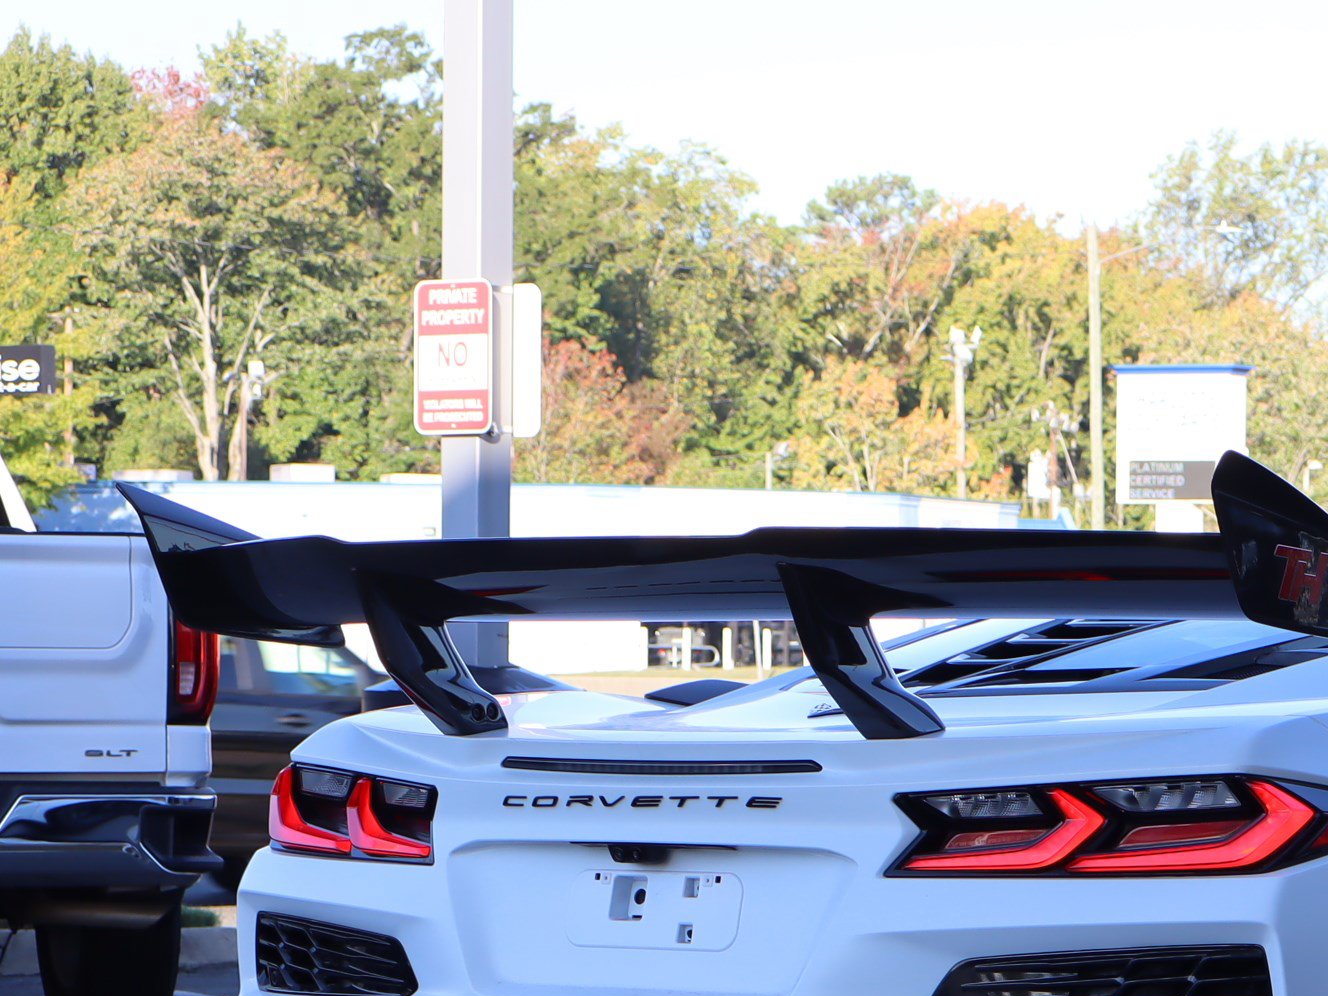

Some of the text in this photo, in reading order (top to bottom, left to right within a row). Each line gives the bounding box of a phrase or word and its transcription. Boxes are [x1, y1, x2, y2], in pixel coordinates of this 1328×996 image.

[429, 288, 477, 305] PRIVATE
[421, 308, 485, 326] PROPERTY
[438, 342, 467, 367] NO
[0, 354, 40, 381] se
[1130, 462, 1185, 474] PLATINUM
[1130, 474, 1186, 487] CERTIFIED
[1129, 488, 1176, 498] SERVICE
[84, 749, 138, 757] SLT
[502, 795, 783, 809] CORVETTE
